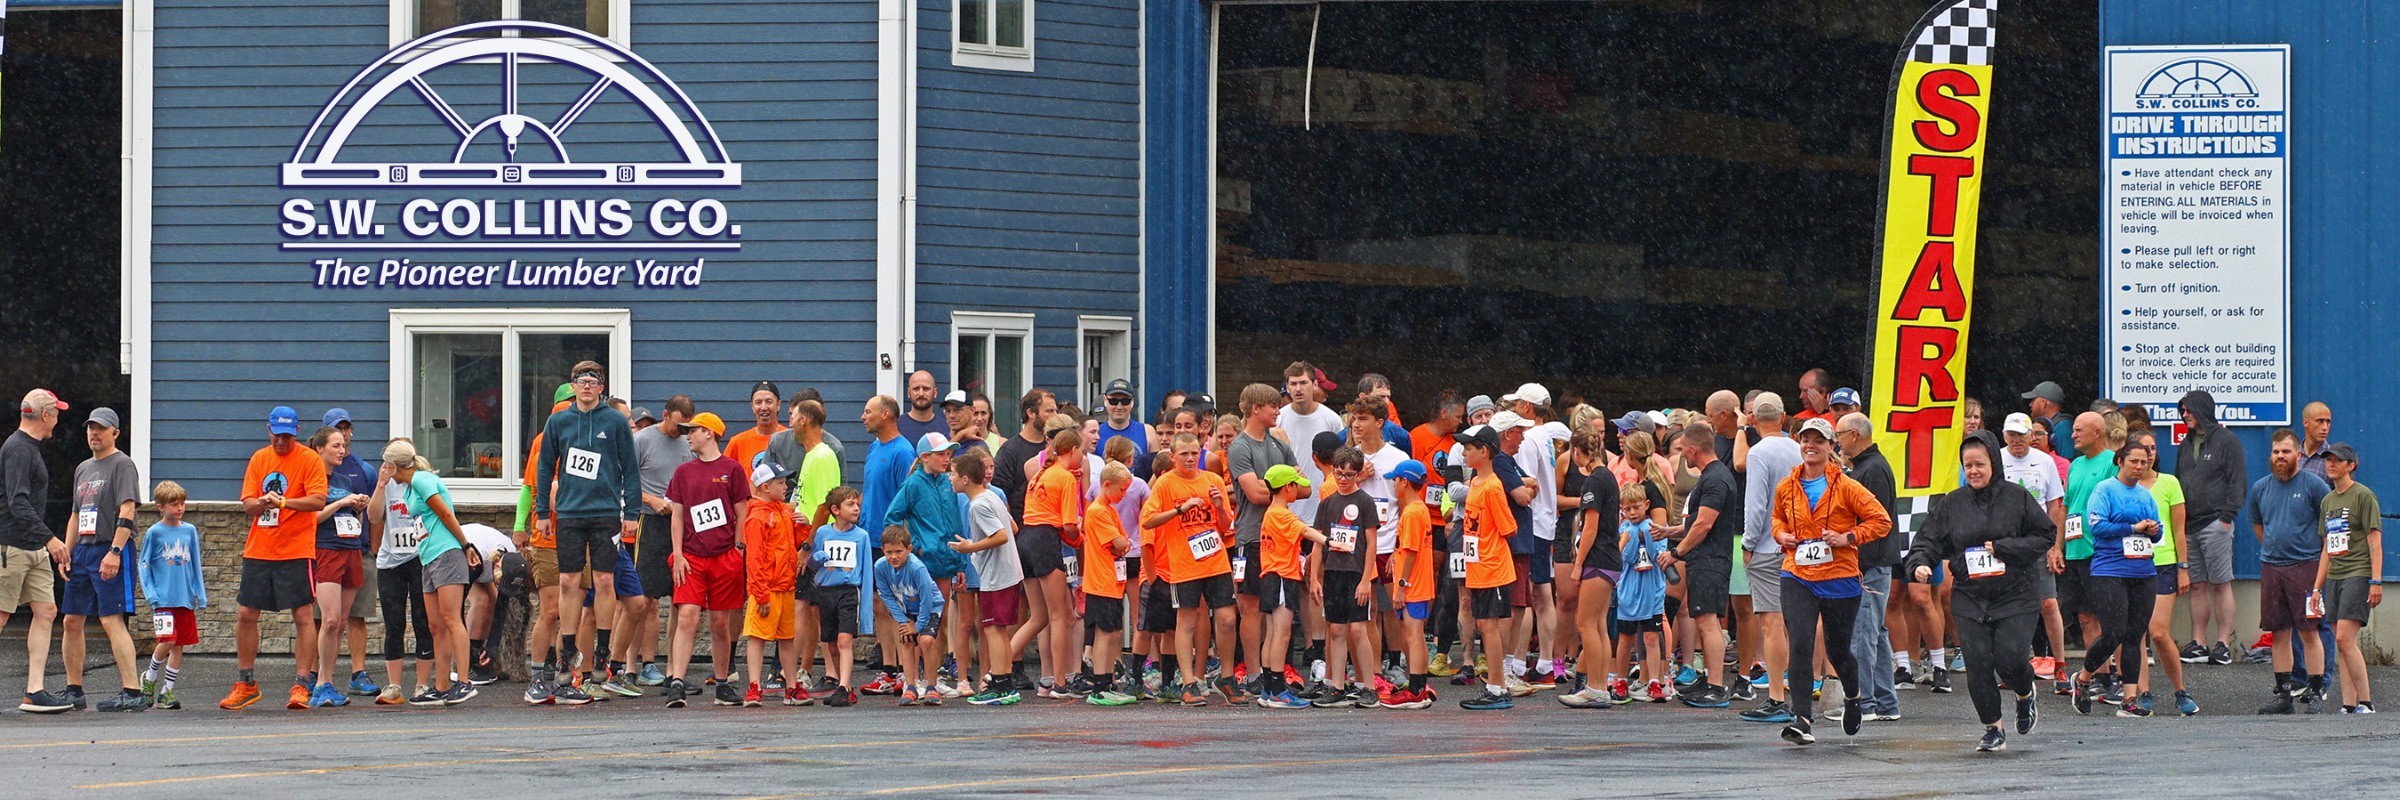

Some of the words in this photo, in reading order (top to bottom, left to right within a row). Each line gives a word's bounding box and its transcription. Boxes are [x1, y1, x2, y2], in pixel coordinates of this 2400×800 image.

[2136, 99, 2166, 109] S.W.
[2172, 99, 2230, 109] COLLINS
[2236, 99, 2260, 109] CO.
[2112, 116, 2174, 134] DRIVE
[2181, 115, 2283, 134] THROUGH
[2118, 136, 2276, 155] INSTRUCTIONS
[2135, 168, 2160, 178] Have
[2165, 168, 2214, 178] attendant
[2219, 168, 2250, 178] check
[2255, 169, 2273, 179] any
[2121, 181, 2162, 191] material
[2167, 181, 2175, 191] in
[2180, 181, 2216, 191] vehicle
[2220, 181, 2262, 191] BEFORE
[2177, 196, 2196, 207] ALL
[2201, 196, 2258, 207] MATERIALS
[2263, 196, 2272, 206] in
[281, 198, 386, 237] S.W.
[402, 198, 633, 237] COLLINS
[649, 198, 742, 237] CO.
[2121, 210, 2157, 220] vehicle
[2161, 210, 2178, 220] will
[2182, 210, 2195, 220] be
[2199, 210, 2242, 220] invoiced
[2246, 210, 2274, 220] when
[2121, 224, 2160, 236] leaving.
[2135, 246, 2170, 256] Please
[2174, 246, 2192, 258] pull
[2197, 246, 2214, 256] left
[2218, 247, 2229, 256] or
[2233, 246, 2256, 258] right
[2121, 260, 2132, 270] to
[2136, 259, 2164, 270] make
[2169, 259, 2219, 270] selection.
[314, 258, 370, 287] The
[379, 258, 499, 287] Pioneer
[507, 258, 626, 287] Lumber
[635, 258, 704, 287] Yard
[1886, 69, 1980, 488] START
[2136, 283, 2157, 293] Turn
[2161, 283, 2176, 293] off
[2180, 283, 2221, 295] ignition.
[2135, 307, 2158, 318] Help
[2163, 307, 2207, 319] yourself,
[2212, 309, 2223, 317] or
[2227, 307, 2245, 317] ask
[2250, 306, 2265, 317] for
[2121, 320, 2180, 331] assistance.
[2136, 343, 2160, 355] Stop
[2164, 344, 2175, 354] at
[2179, 344, 2210, 354] check
[2215, 344, 2232, 354] out
[2236, 343, 2276, 355] building
[2121, 357, 2135, 367] for
[2140, 357, 2176, 367] invoice.
[2180, 357, 2211, 367] Clerks
[2215, 358, 2231, 367] are
[2235, 357, 2275, 369] required
[2121, 371, 2132, 380] to
[2137, 370, 2168, 380] check
[2172, 370, 2208, 380] vehicle
[2213, 370, 2227, 380] for
[2232, 370, 2277, 380] accurate
[2121, 384, 2169, 395] inventory
[2173, 384, 2192, 394] and
[2196, 384, 2233, 394] invoice
[2237, 384, 2278, 394] amount.
[2143, 404, 2181, 420] Tha
[2215, 404, 2257, 420] You.
[570, 454, 595, 473] 126
[697, 506, 721, 525] 133
[347, 519, 353, 531] 6
[2067, 521, 2075, 533] 24
[395, 533, 417, 547] 116
[1198, 536, 1216, 552] 100
[2133, 540, 2145, 552] 53
[2330, 536, 2340, 549] 83
[829, 546, 851, 561] 117
[1805, 545, 1821, 560] 42
[1978, 554, 1992, 568] 41
